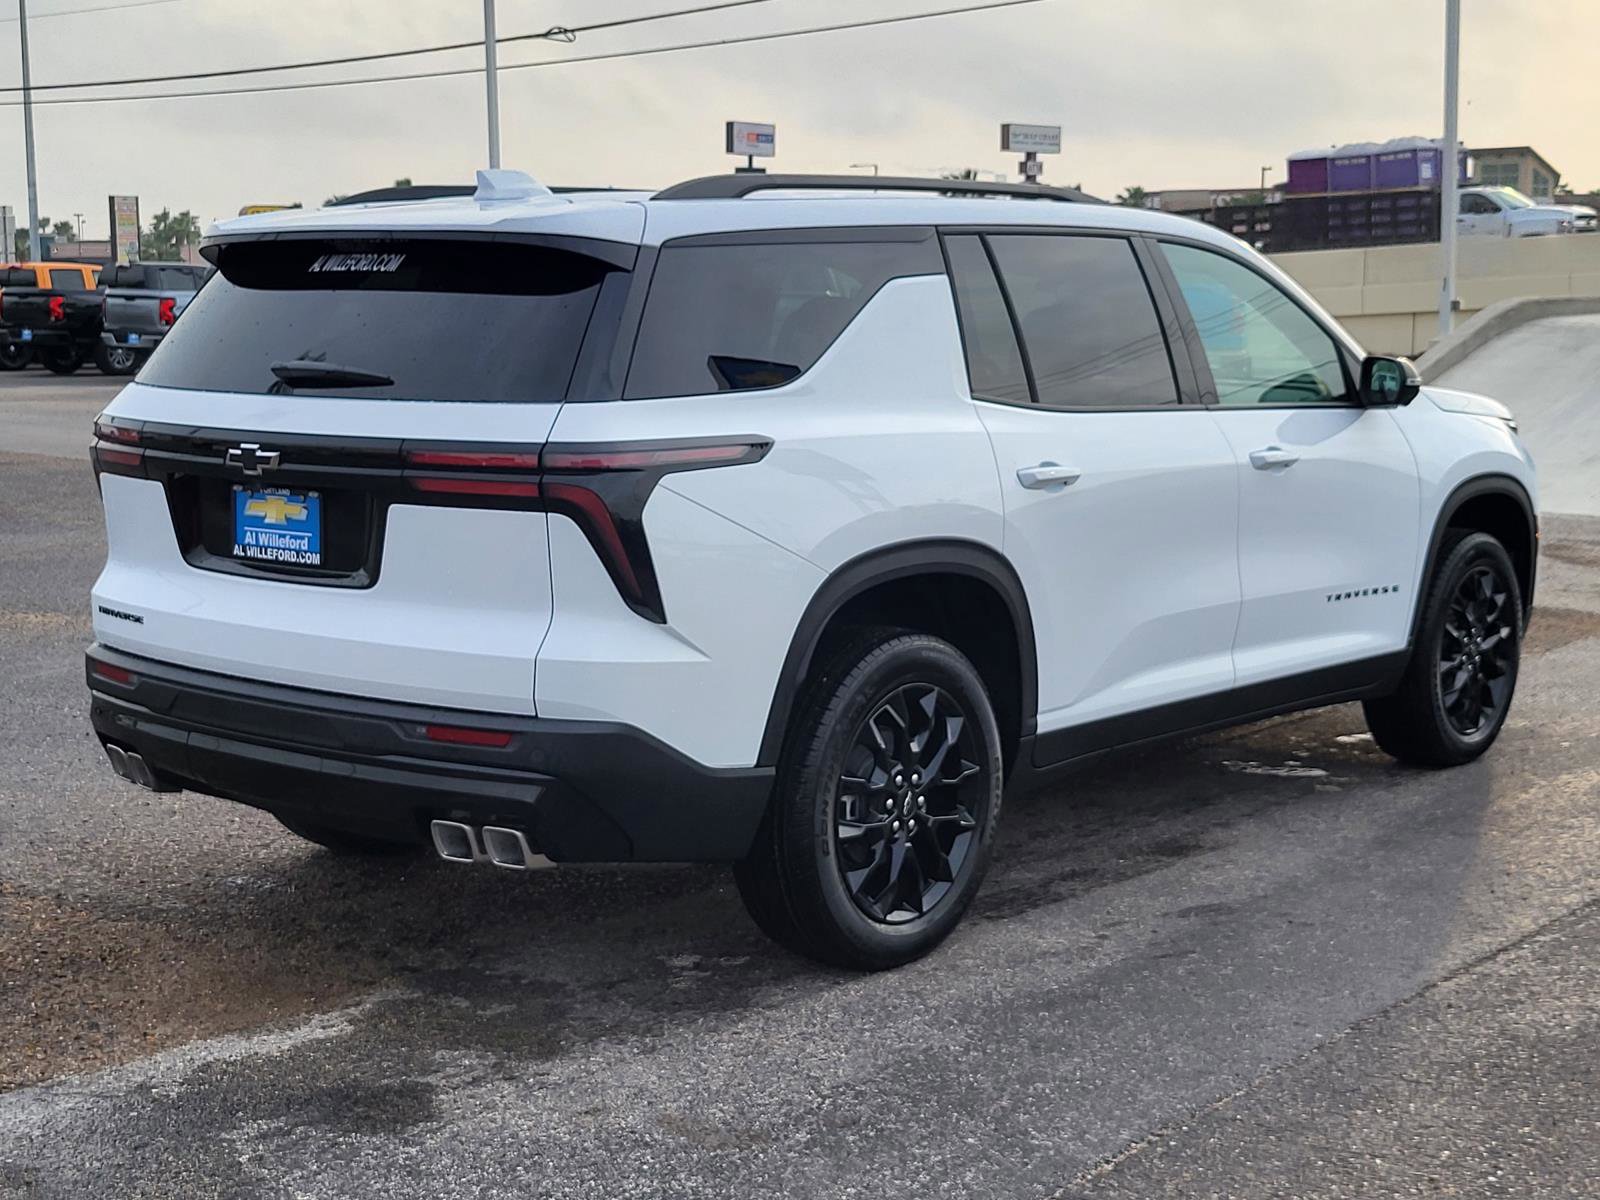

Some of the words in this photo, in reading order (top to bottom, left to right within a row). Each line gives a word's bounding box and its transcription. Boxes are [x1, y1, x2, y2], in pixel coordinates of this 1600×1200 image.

[258, 532, 309, 550] Willeford
[233, 544, 245, 556] AL
[246, 546, 320, 565] WILLEFORD.COM
[1326, 584, 1399, 602] TRAVERSE
